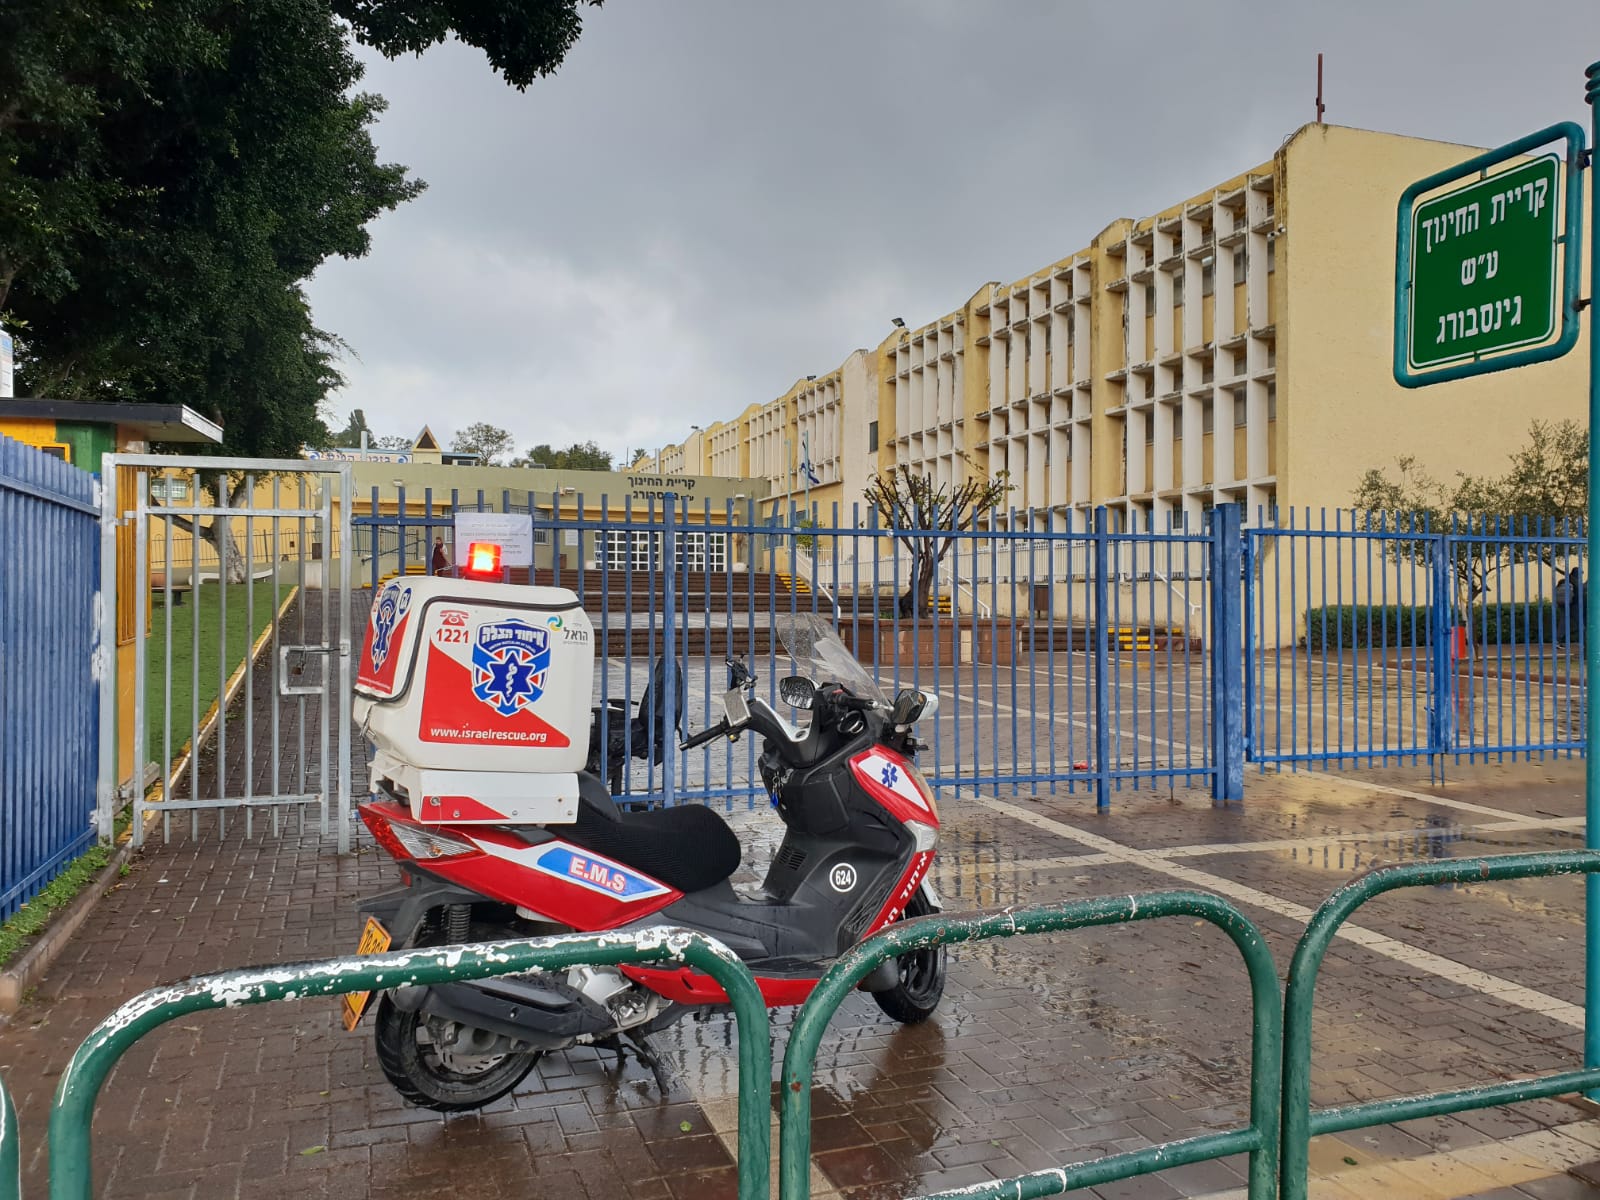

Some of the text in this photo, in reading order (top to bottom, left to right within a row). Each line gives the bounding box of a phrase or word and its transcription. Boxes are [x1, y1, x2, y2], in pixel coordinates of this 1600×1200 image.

[1422, 177, 1549, 253] קריית החינוך
[1461, 250, 1499, 285] ע"ש
[1436, 295, 1522, 344] גינסבורג
[627, 476, 696, 490] קריית החינוך
[436, 628, 469, 644] 1221
[481, 625, 513, 645] הצלה
[514, 629, 545, 648] איחוד
[563, 626, 588, 641] הראל
[430, 728, 547, 743] www.israelrescue.org
[570, 856, 626, 893] E.M.S
[835, 869, 851, 886] 624
[900, 851, 928, 900] איחוד
